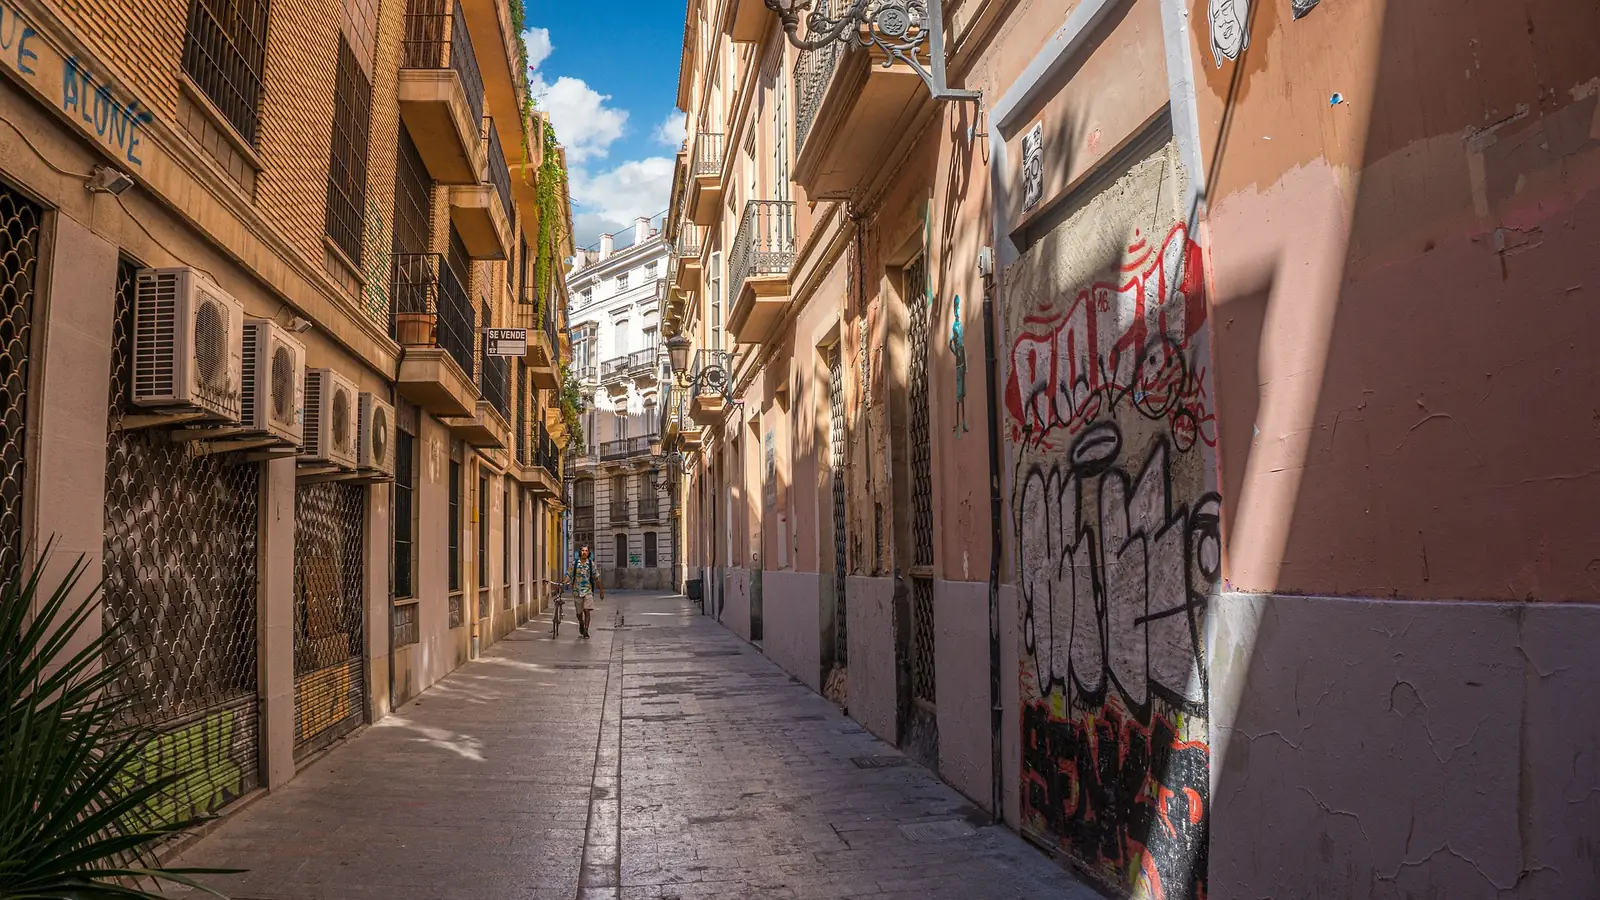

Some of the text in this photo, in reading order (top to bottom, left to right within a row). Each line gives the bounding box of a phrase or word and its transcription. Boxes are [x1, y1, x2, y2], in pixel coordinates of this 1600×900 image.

[63, 56, 152, 166] ALONE
[489, 330, 526, 339] SE VENDE
